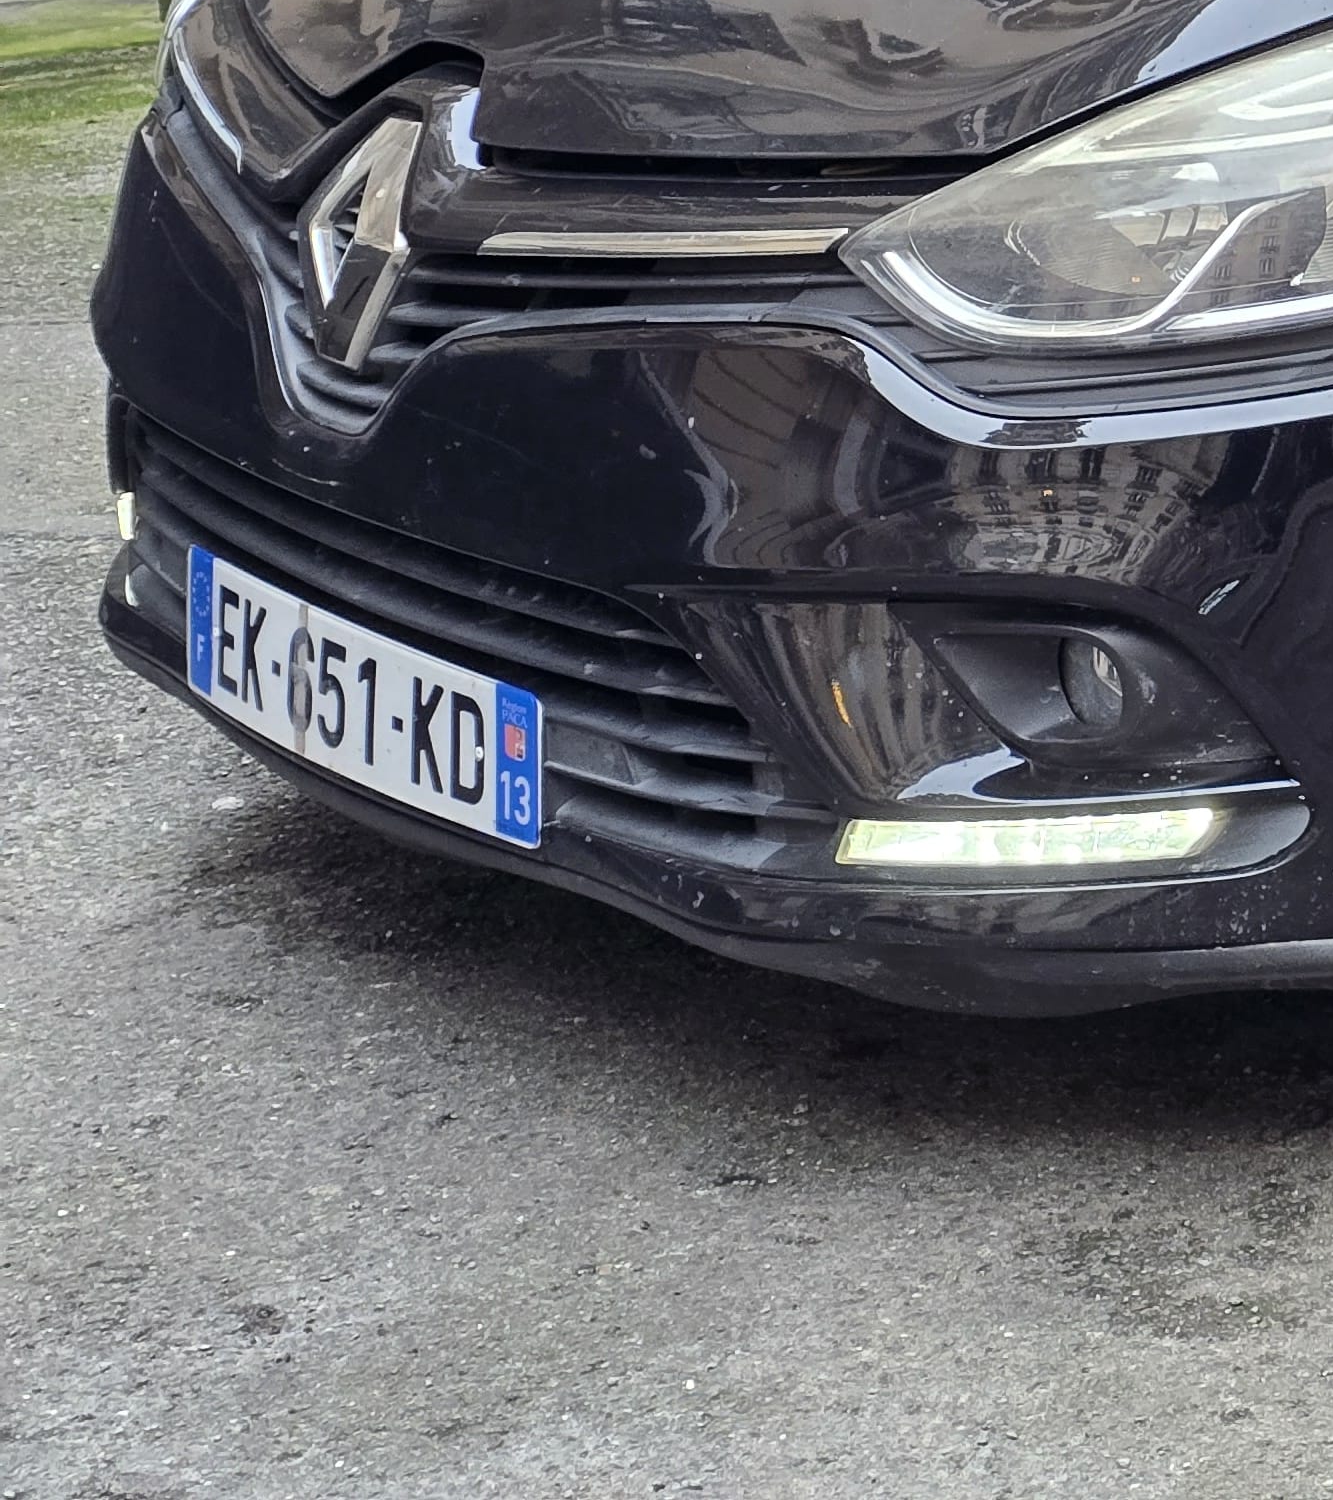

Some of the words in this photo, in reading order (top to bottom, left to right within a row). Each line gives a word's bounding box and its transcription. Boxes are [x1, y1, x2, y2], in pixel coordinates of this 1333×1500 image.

[197, 634, 206, 662] F
[217, 584, 484, 806] EK-651-KD
[502, 708, 528, 729] PACA
[500, 771, 531, 826] 13
